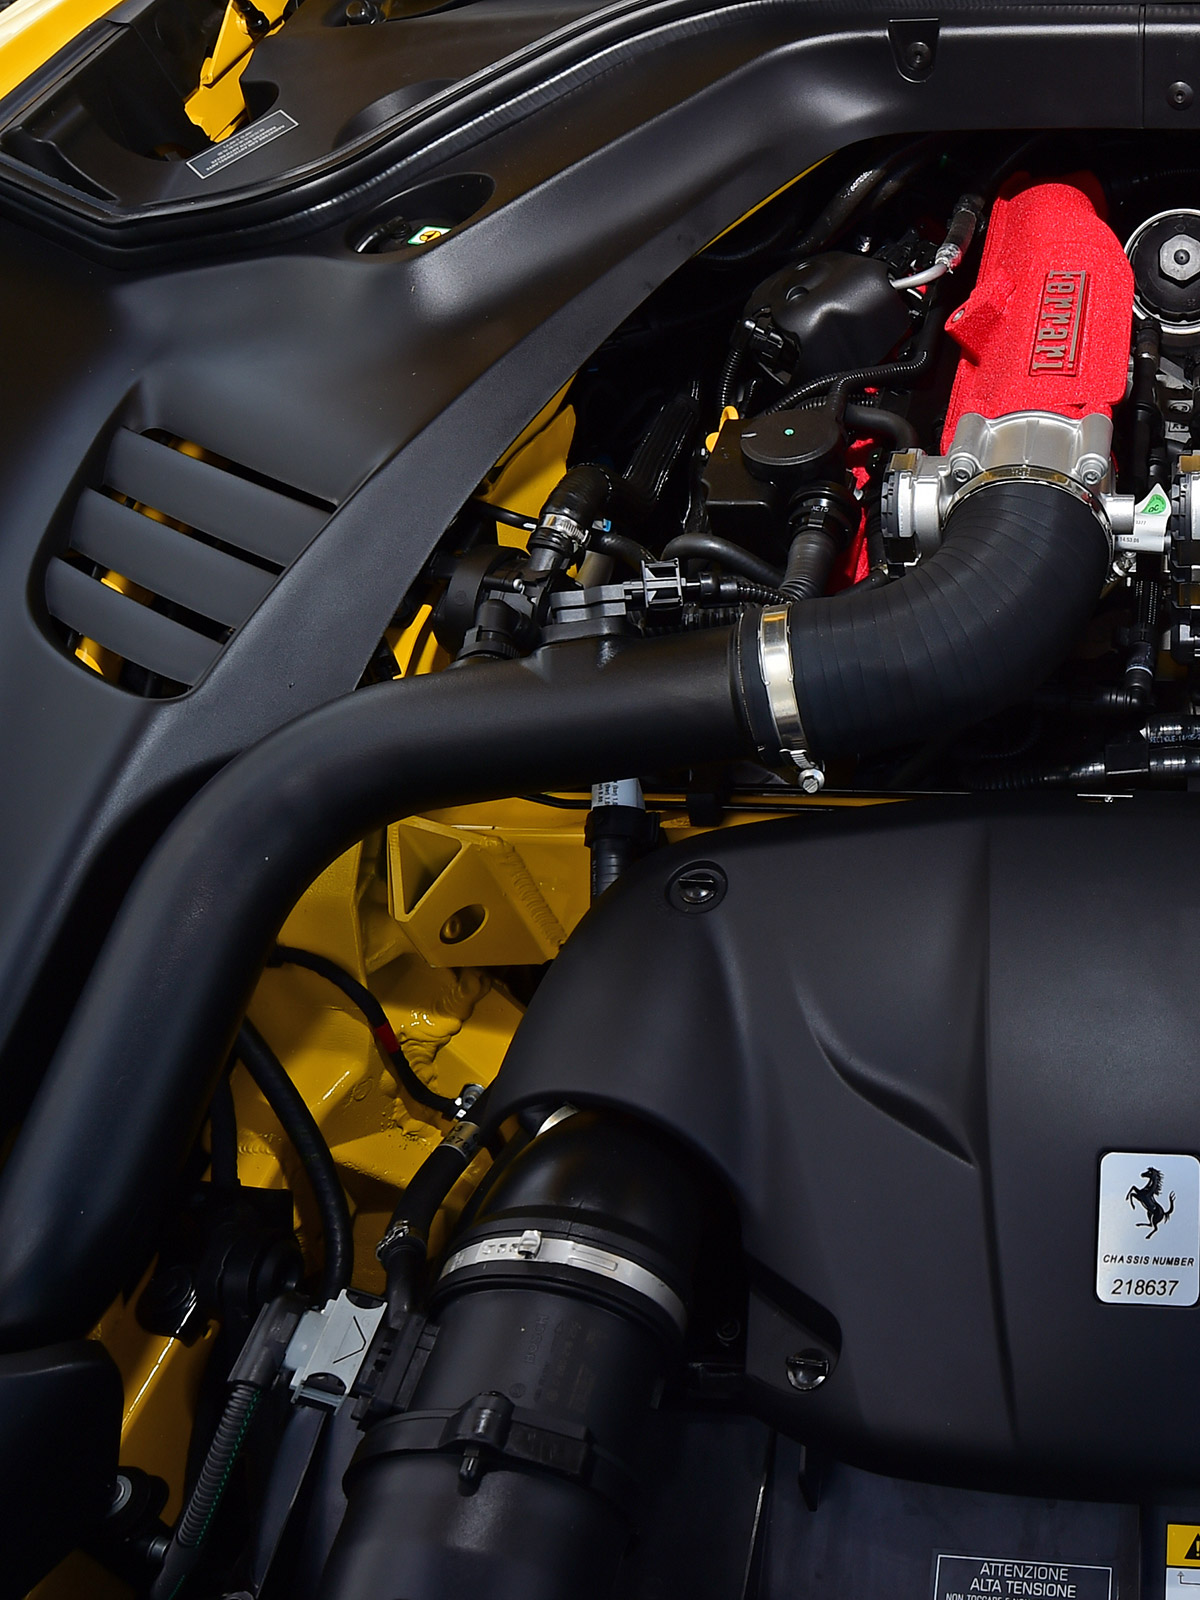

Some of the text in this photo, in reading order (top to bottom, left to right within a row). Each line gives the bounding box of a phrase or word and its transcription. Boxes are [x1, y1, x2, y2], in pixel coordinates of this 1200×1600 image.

[1032, 270, 1086, 370] Ferrari
[1103, 1254, 1195, 1267] CHASSIS NUMBER
[1111, 1278, 1180, 1297] 218637
[979, 1562, 1069, 1582] ATTENZIONE
[970, 1578, 1077, 1598] ALTA TENSIONE
